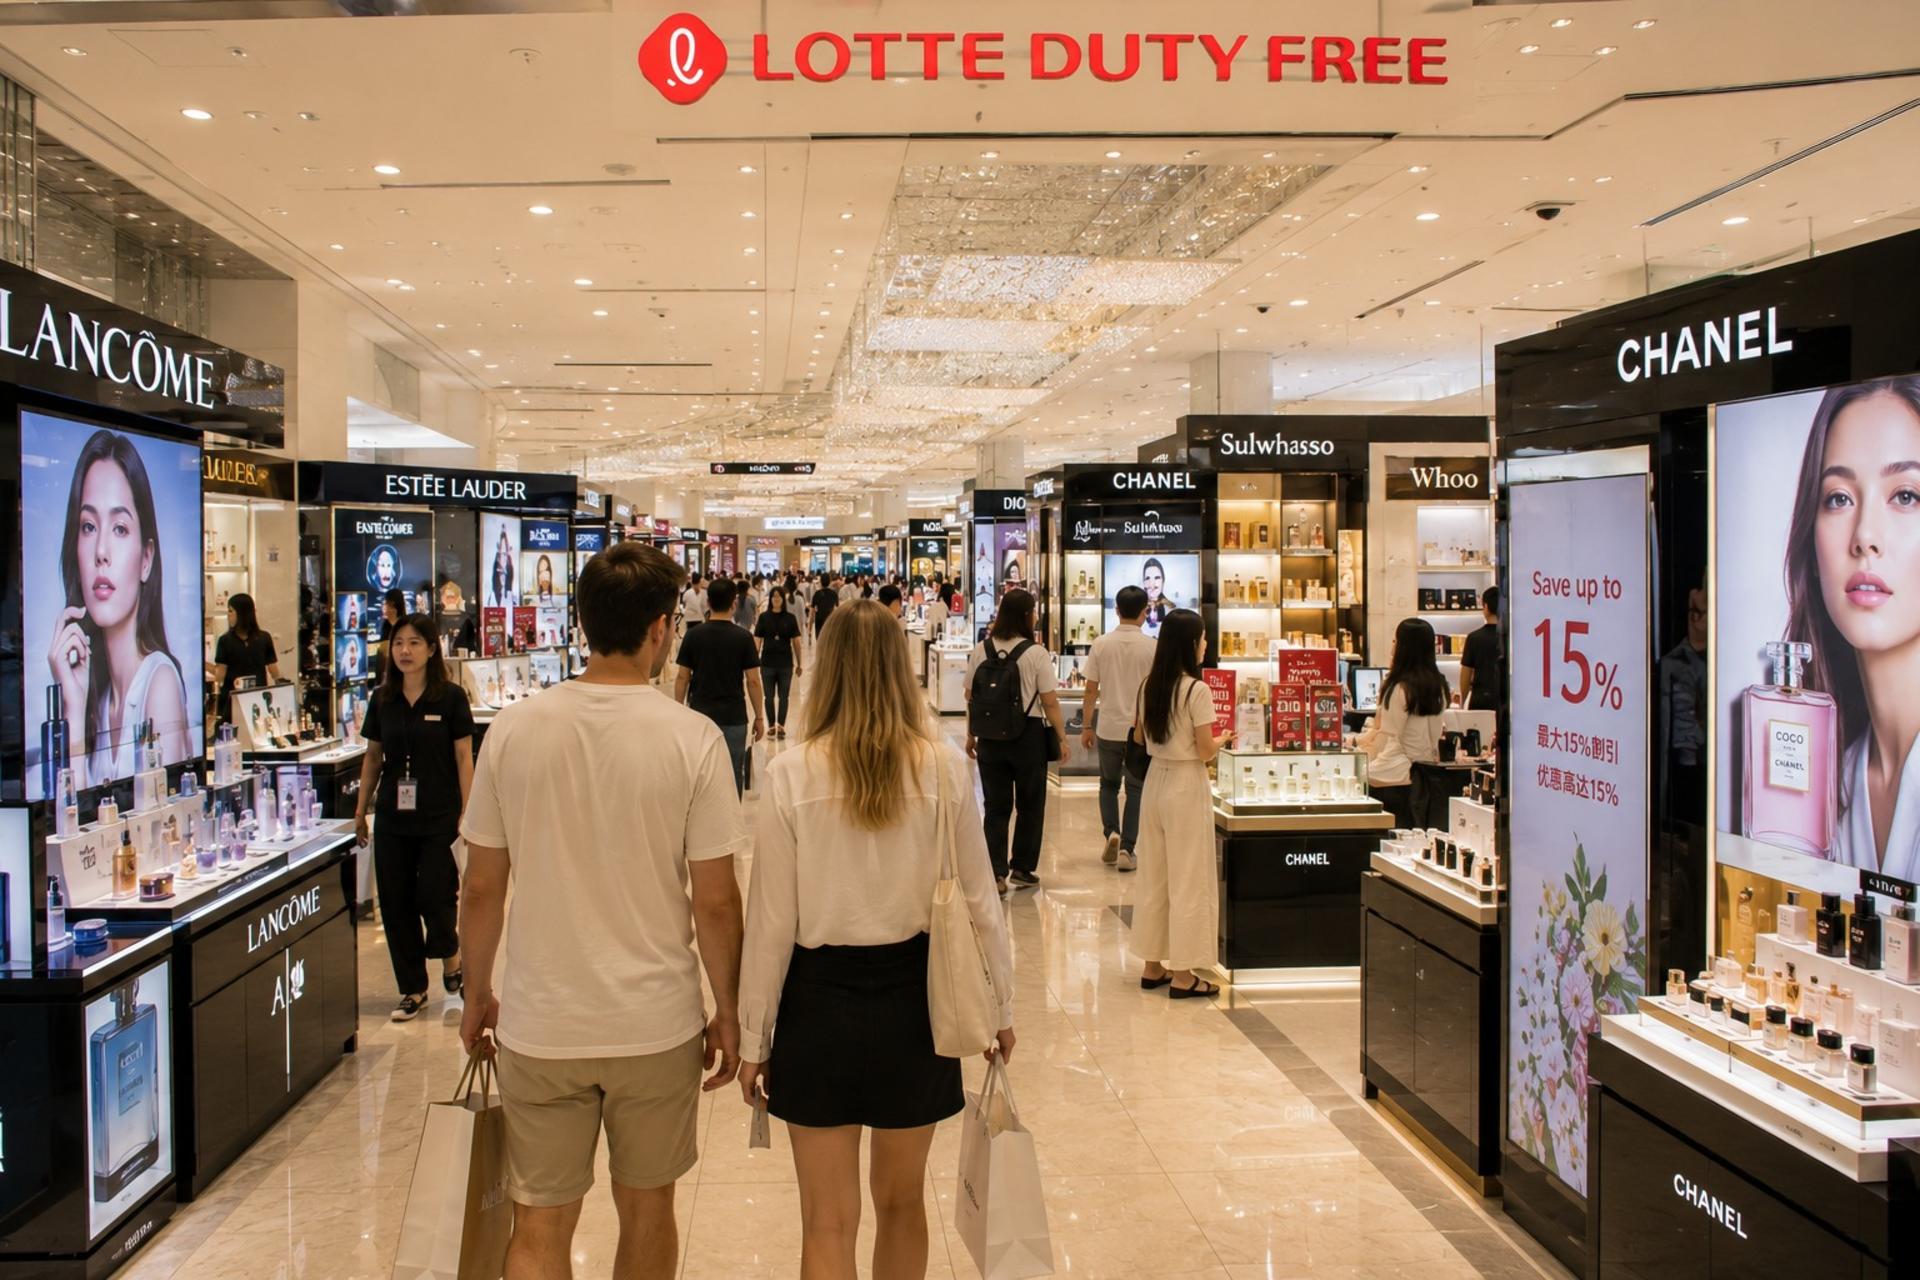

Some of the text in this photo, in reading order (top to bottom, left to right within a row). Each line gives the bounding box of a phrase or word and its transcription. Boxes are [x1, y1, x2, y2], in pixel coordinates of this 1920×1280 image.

[753, 32, 1449, 85] LOTTE DUTY FREE
[0, 288, 215, 410] LANCÔME
[1617, 305, 1793, 383] CHANEL
[1220, 432, 1335, 456] Sulwhasso
[451, 478, 527, 500] LAUDER
[1112, 472, 1197, 490] CHANEL
[1409, 466, 1479, 489] Whoo
[1532, 570, 1623, 605] Save up to
[1534, 617, 1624, 711] 15%
[1536, 723, 1619, 765] 最大15%割引
[1775, 731, 1804, 745] COCO
[1536, 763, 1620, 807] 优惠高达15%
[247, 885, 321, 954] LANCÔME
[1672, 1172, 1749, 1240] CHANEL
